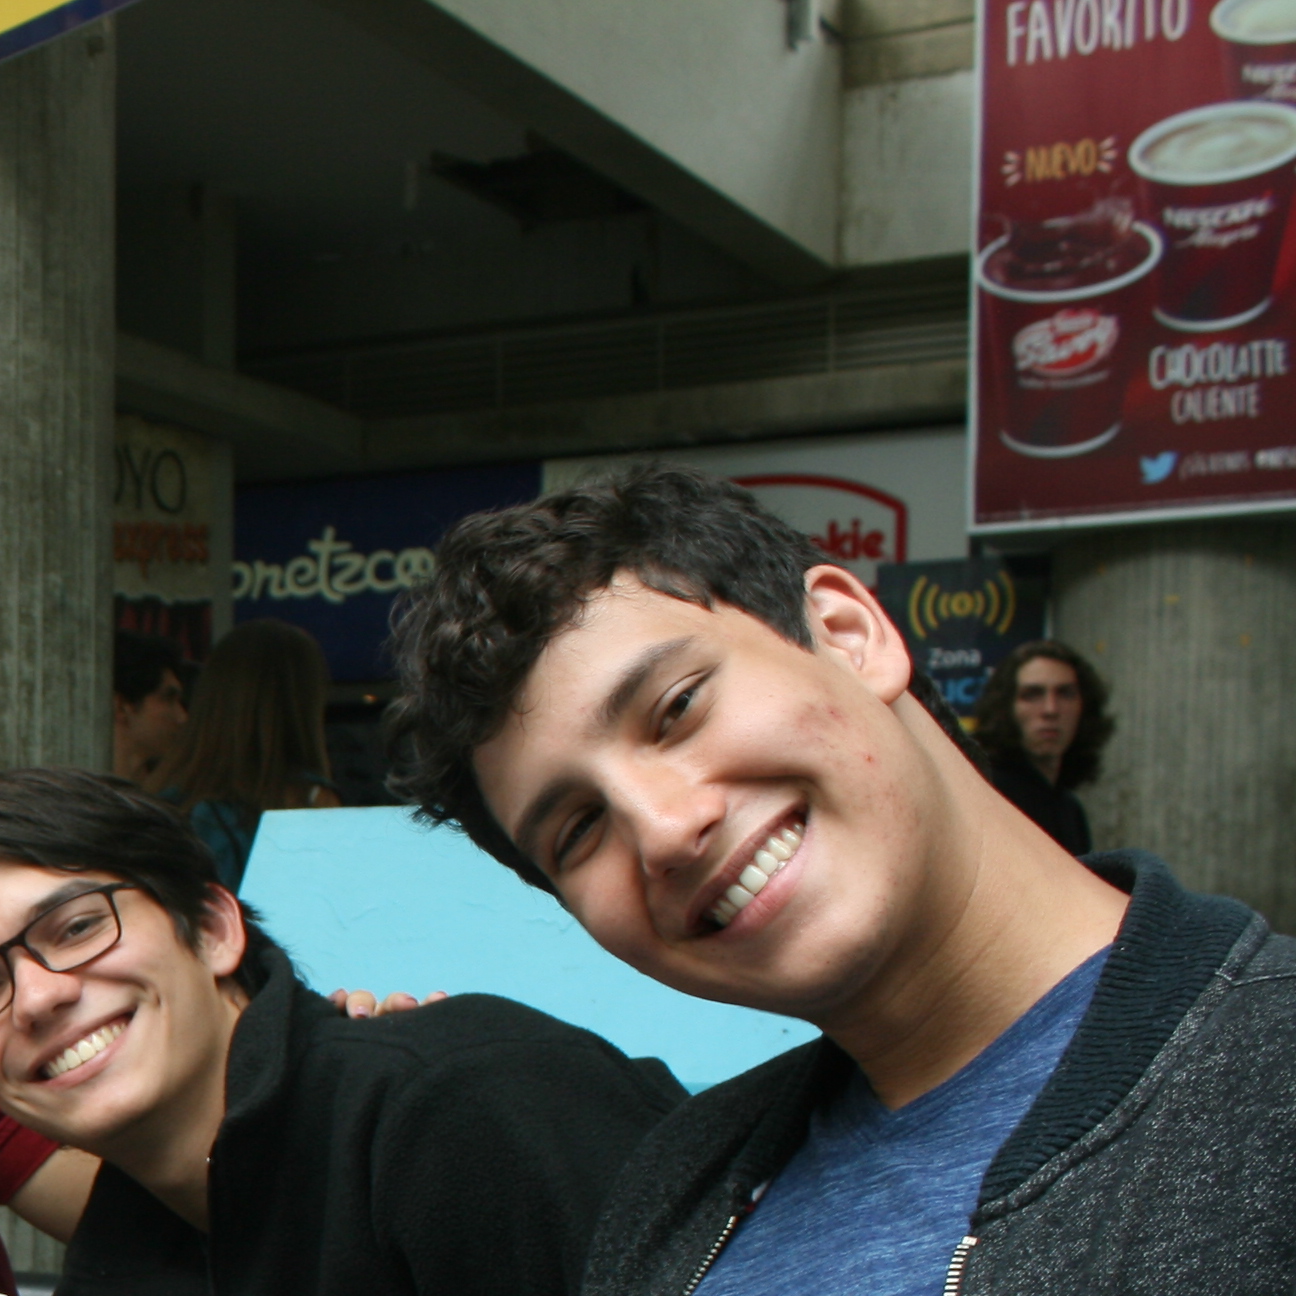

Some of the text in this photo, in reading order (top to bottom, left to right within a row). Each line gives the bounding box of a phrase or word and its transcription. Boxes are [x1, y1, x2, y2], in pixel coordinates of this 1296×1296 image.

[1006, 0, 1191, 67] FAVORITO
[1025, 138, 1099, 183] NUEVO
[1148, 338, 1288, 391] CHOCOLATTE
[1170, 382, 1259, 425] CALIENTE
[810, 518, 886, 559] kie
[928, 647, 983, 670] Zona
